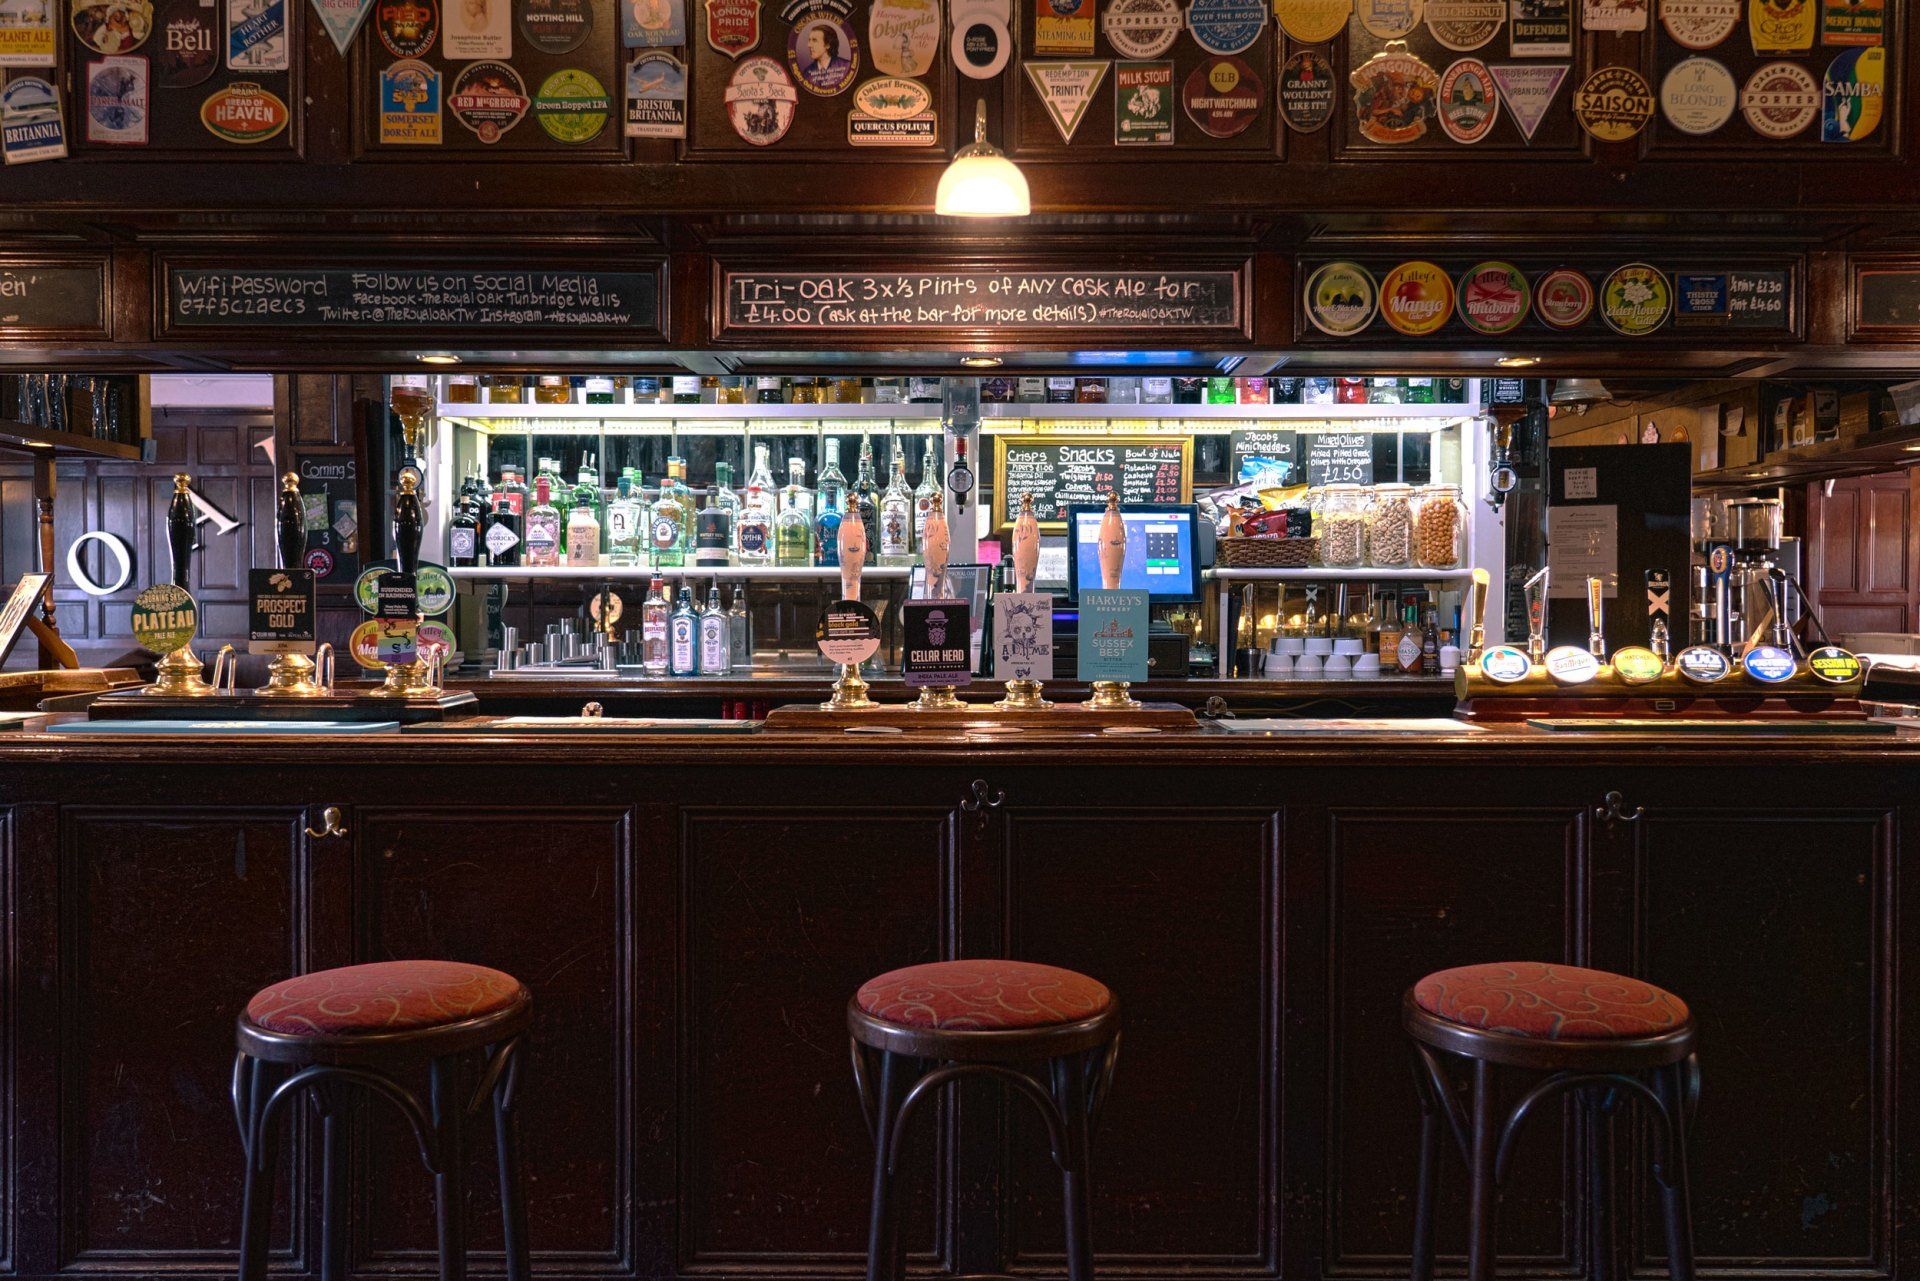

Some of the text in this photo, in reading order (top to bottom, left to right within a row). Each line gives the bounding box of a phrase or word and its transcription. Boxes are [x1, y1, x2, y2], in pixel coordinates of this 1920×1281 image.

[712, 7, 754, 18] LONDON
[1430, 7, 1500, 17] OLD CHESTNUT
[1665, 6, 1735, 15] DARK STAR
[526, 14, 584, 22] NOTTING HILL
[719, 18, 749, 26] PRIDE
[1108, 17, 1179, 25] ESPRESSO
[1192, 13, 1216, 21] OVER
[1235, 12, 1262, 20] MOON
[873, 13, 936, 39] Olympia
[1516, 23, 1567, 36] DEFENDER
[1671, 20, 1729, 42] THE ORIGINAL
[166, 29, 212, 51] Bell
[1037, 31, 1093, 41] STEAMING ALE
[1045, 70, 1090, 78] REDEMPTION
[1214, 72, 1236, 83] ELB
[1362, 61, 1432, 83] HOBGOBLIN
[1500, 69, 1559, 78] REDEMPTION
[1119, 71, 1171, 85] MILK STOUT
[1588, 71, 1645, 95] DARK STAR
[1753, 68, 1810, 90] DARK STAR
[862, 80, 924, 97] Oakleaf Brewery
[1287, 80, 1328, 89] GRANNY
[1684, 84, 1713, 94] LONG
[1825, 81, 1883, 97] SAMBA
[231, 88, 258, 96] BRAINS
[1050, 85, 1085, 97] TRINITY
[1282, 91, 1333, 100] WOULDN'T
[1508, 87, 1550, 96] URBAN DUSK
[457, 96, 474, 108] RED
[1582, 94, 1650, 112] SAISON
[1670, 93, 1726, 105] BLONDE
[1748, 95, 1814, 104] PORTER
[537, 102, 561, 110] Green
[637, 100, 675, 111] BRISTOL
[1288, 102, 1307, 111] LIKE
[215, 105, 274, 123] HEAVEN
[386, 115, 435, 124] SOMERSET
[629, 110, 682, 122] BRITANNIA
[384, 128, 437, 137] DORSET ALE
[854, 122, 931, 132] QUERCUS FOLIUM
[5, 123, 61, 143] BRITANNIA
[1399, 271, 1437, 282] Lilley's
[179, 274, 327, 297] Wifi Password
[352, 272, 598, 294] Follow us on Social Media
[919, 277, 977, 296] Pints
[988, 276, 1012, 295] of
[1017, 278, 1056, 295] ANY
[1061, 277, 1110, 297] Cask
[1115, 278, 1145, 297] Ale
[1153, 276, 1200, 300] for
[442, 292, 475, 306] Royal
[506, 292, 575, 309] Tunbridge
[579, 293, 621, 307] wells
[1686, 291, 1719, 299] THISTLY
[179, 297, 305, 316] e7f5c2aec3
[1391, 295, 1444, 318] Mango
[1467, 299, 1521, 315] Rhubarb
[1545, 299, 1583, 311] Strawberry
[1690, 298, 1716, 306] CROSS
[1730, 295, 1781, 312] Pint £4.60
[745, 304, 811, 323] £4.00
[818, 305, 855, 325] (ask
[860, 308, 878, 323] at
[880, 306, 912, 323] the
[917, 306, 949, 322] bar
[951, 304, 982, 322] for
[985, 306, 1028, 322] more
[1032, 302, 1097, 323] details)
[1606, 304, 1667, 317] Elderflower
[1407, 313, 1425, 321] Cider
[1485, 314, 1502, 322] Cider
[1635, 316, 1657, 326] Cider
[1244, 432, 1279, 441] Jacobs
[1317, 434, 1366, 446] Mixed Olives
[1235, 441, 1252, 451] Mini
[1007, 450, 1048, 463] Crisps
[1059, 446, 1116, 463] Snacks
[1125, 448, 1181, 460] Bowl of Nuts
[301, 460, 346, 480] Coming
[1012, 463, 1035, 472] Pipers
[1124, 463, 1157, 471] Pistachio
[1321, 465, 1363, 483] £2.50
[322, 531, 330, 545] 3
[741, 534, 762, 542] OPIHR
[256, 599, 307, 614] PROSPECT
[1086, 596, 1142, 606] HARVEY'S
[133, 609, 195, 632] PLATEAU
[269, 614, 295, 629] GOLD
[845, 621, 859, 629] gold
[154, 632, 165, 640] PALE
[1092, 639, 1134, 648] SUSSEX
[911, 649, 965, 663] CELLAR HEAD
[1099, 648, 1127, 657] BEST
